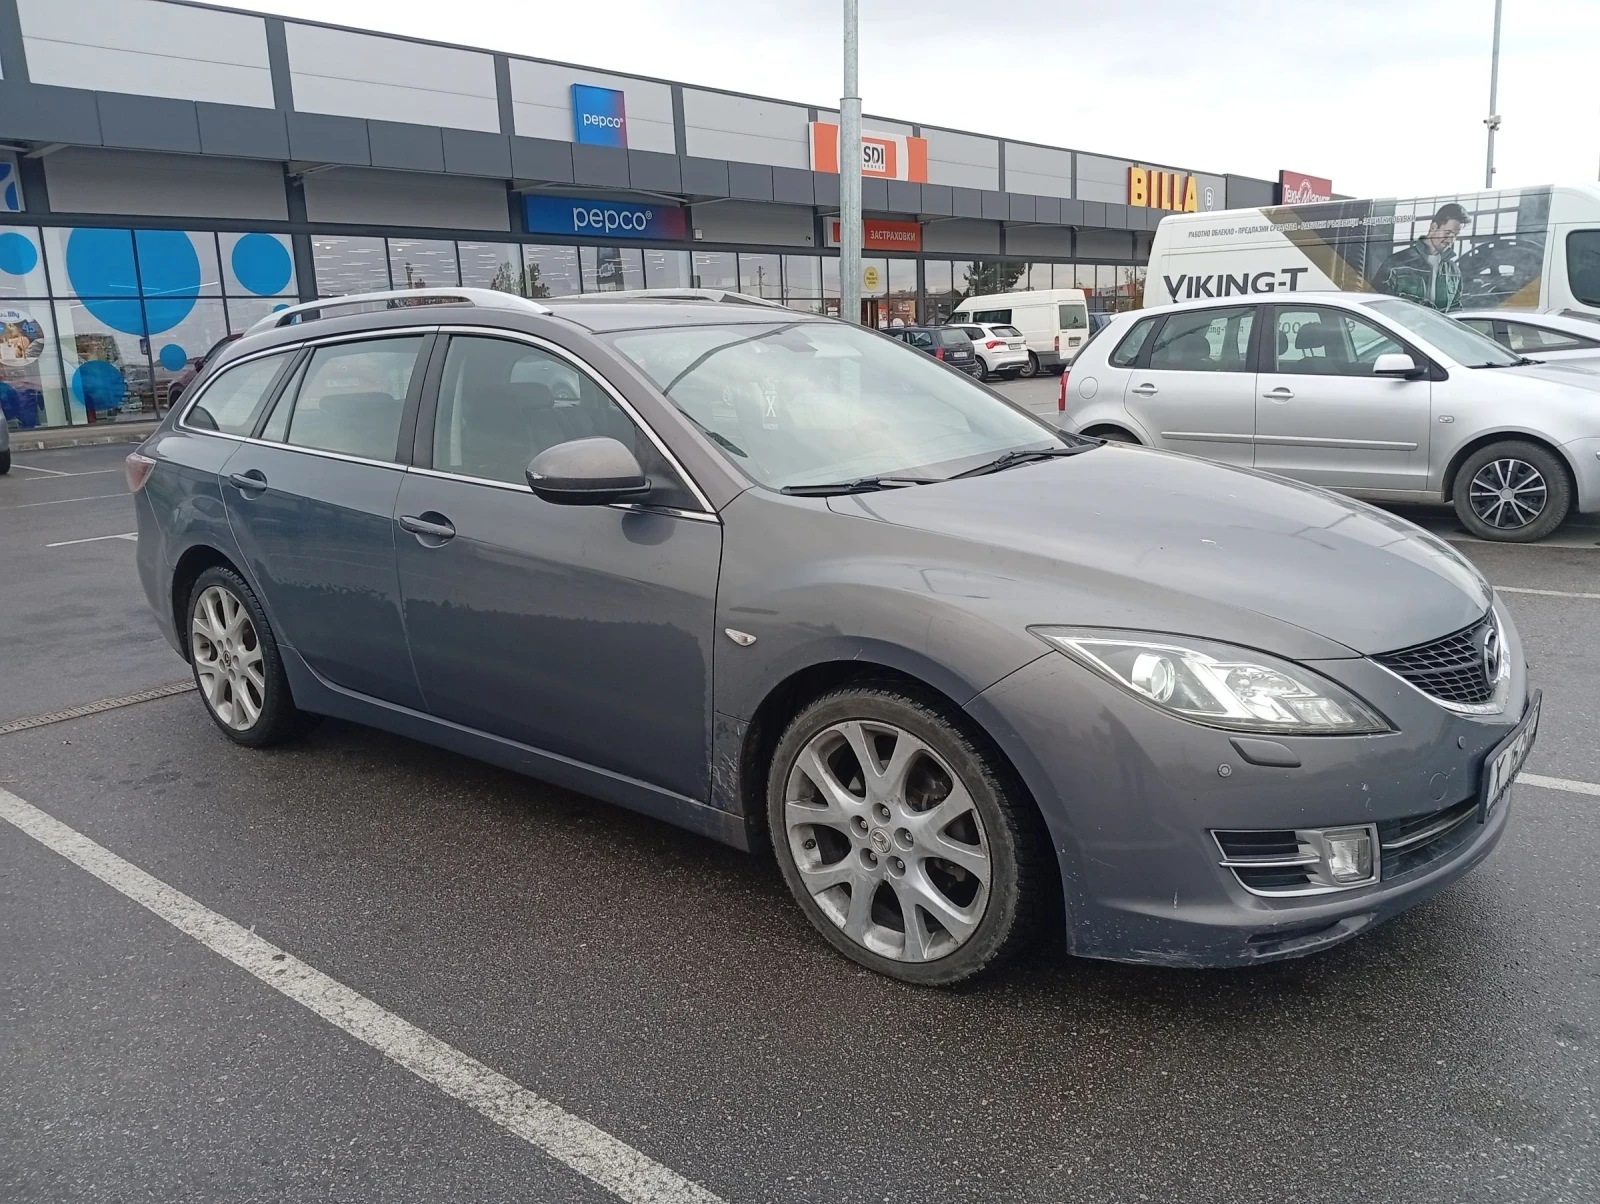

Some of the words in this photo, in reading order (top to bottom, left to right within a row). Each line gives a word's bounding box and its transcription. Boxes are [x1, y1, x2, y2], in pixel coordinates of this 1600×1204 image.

[863, 145, 884, 165] SDI
[1129, 167, 1198, 212] BILLA
[870, 230, 916, 241] ЗАСТРАХОВКИ
[1188, 229, 1211, 238] РАБОТНО
[1211, 227, 1234, 237] ОБЛЕКЛО
[1238, 225, 1269, 235] ПРЕДПАЗНИ
[1163, 267, 1308, 299] VIKING-T
